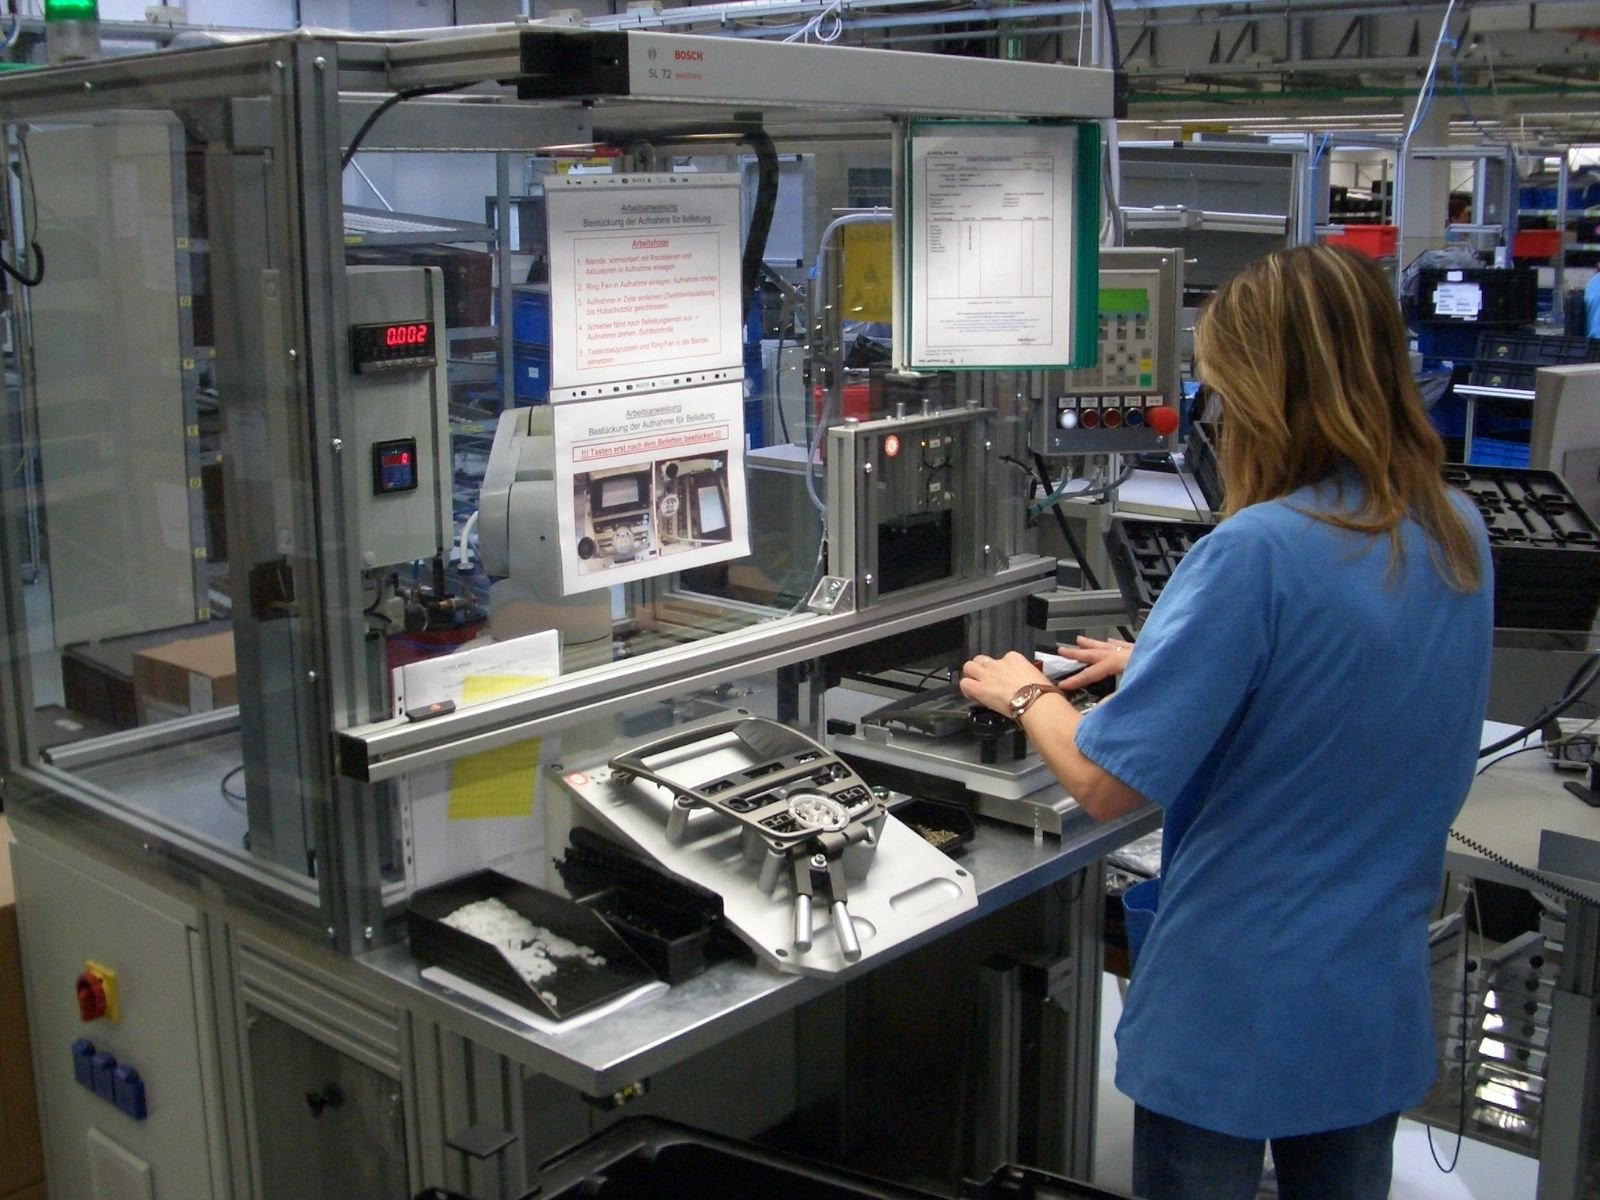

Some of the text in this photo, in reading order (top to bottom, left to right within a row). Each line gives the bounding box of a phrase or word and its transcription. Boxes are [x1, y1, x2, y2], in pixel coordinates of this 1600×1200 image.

[674, 50, 703, 61] BOSCH
[648, 67, 658, 79] SL
[661, 68, 672, 79] 72
[621, 204, 678, 214] Arbeitsanweisung
[583, 218, 624, 228] Bestückung
[626, 217, 636, 226] der
[638, 216, 670, 225] Aufnahme
[672, 215, 681, 223] für
[632, 239, 669, 249] Arbeitsfolge
[387, 325, 427, 345] 0.002
[626, 404, 682, 419] Arbeitsanweisung
[588, 424, 629, 436] Bestückung
[630, 423, 640, 432] der
[642, 418, 674, 429] Aufnahme
[676, 416, 684, 425] für
[590, 446, 612, 458] Tasten
[613, 445, 626, 455] erst
[626, 442, 642, 453] nach
